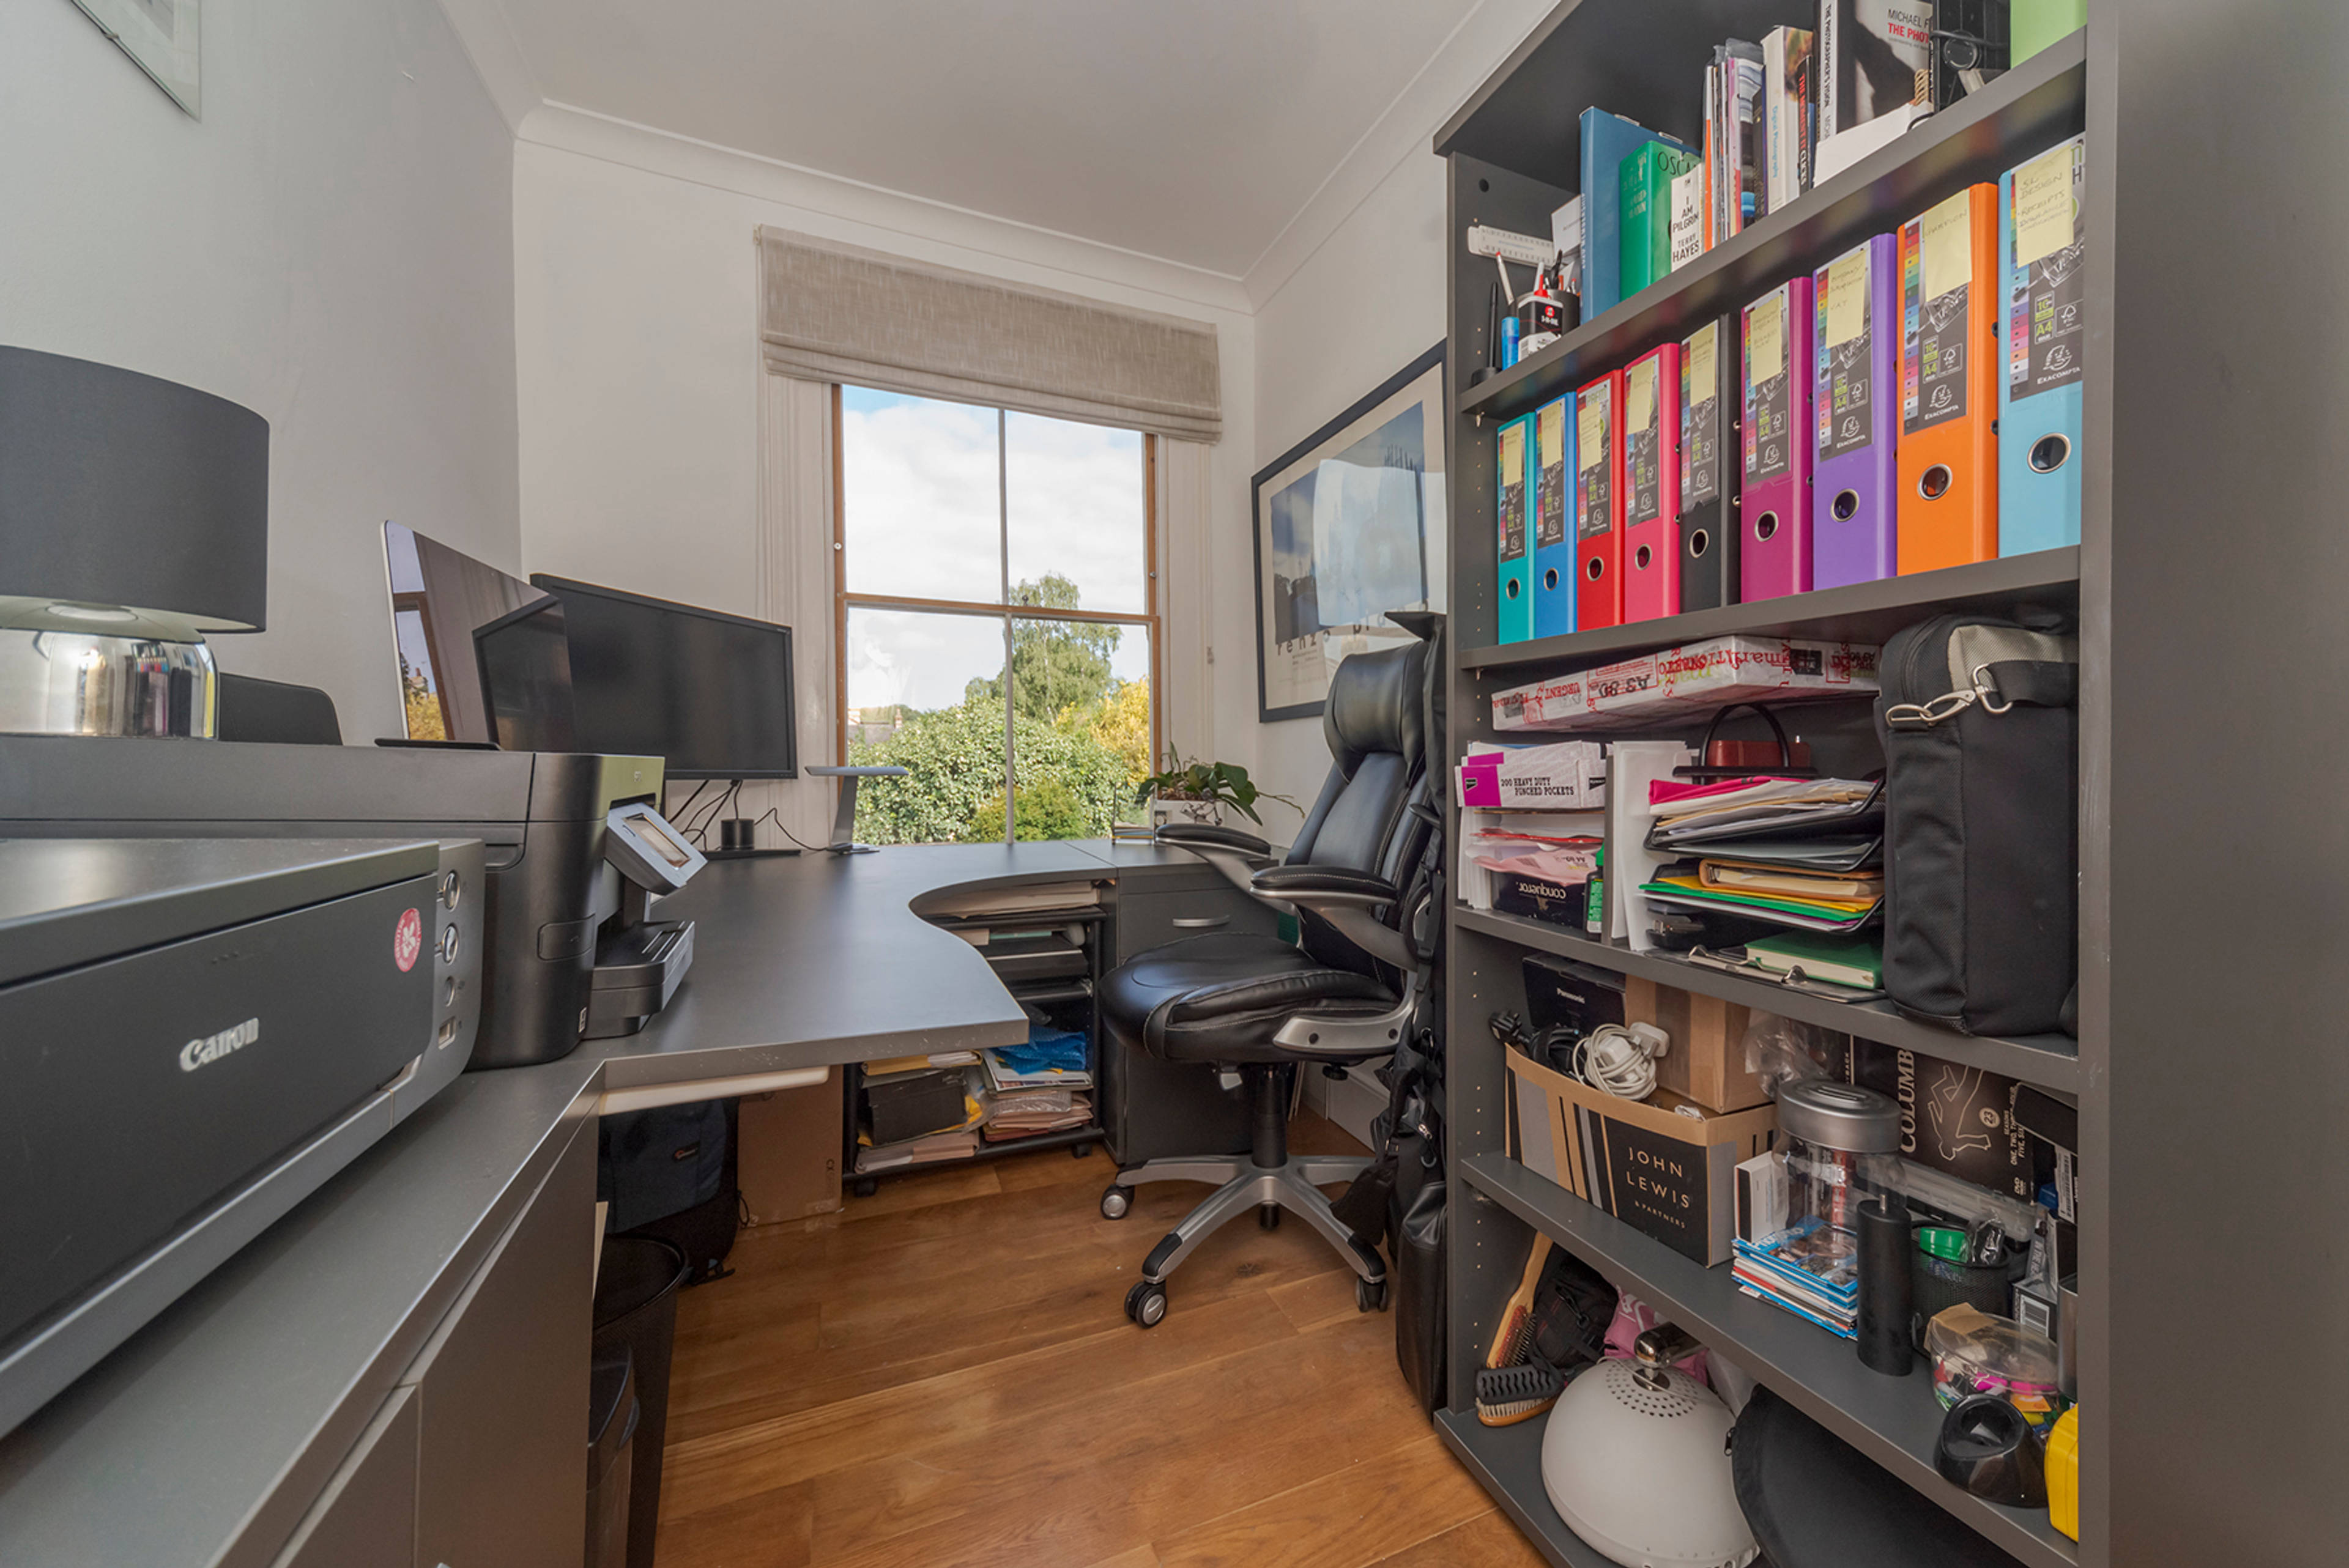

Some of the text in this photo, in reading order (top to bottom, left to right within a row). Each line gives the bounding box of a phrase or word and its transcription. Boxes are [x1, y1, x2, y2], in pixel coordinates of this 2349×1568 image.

[1888, 9, 1921, 28] MICHAEL
[1888, 22, 1905, 37] THE
[1657, 152, 1698, 177] OSCA
[1681, 205, 1693, 218] AM
[1672, 213, 1699, 233] PILGRIM
[1677, 233, 1696, 248] TERRY
[1672, 240, 1699, 262] HAYES
[2036, 320, 2053, 336] A4
[1545, 682, 1581, 700] URGENT
[1598, 681, 1619, 698] 80
[1625, 674, 1651, 693] A3
[1501, 777, 1551, 787] 200 HEAVY DUTY
[1515, 786, 1575, 796] PUNCHED POCKETS
[179, 1017, 259, 1072] Canon
[1898, 1049, 1917, 1153] COLUMB
[1983, 1110, 1994, 1124] 23
[1629, 1147, 1682, 1178] JOHN
[1627, 1170, 1689, 1208] LEWIS
[1642, 1203, 1685, 1229] PARTNERS
